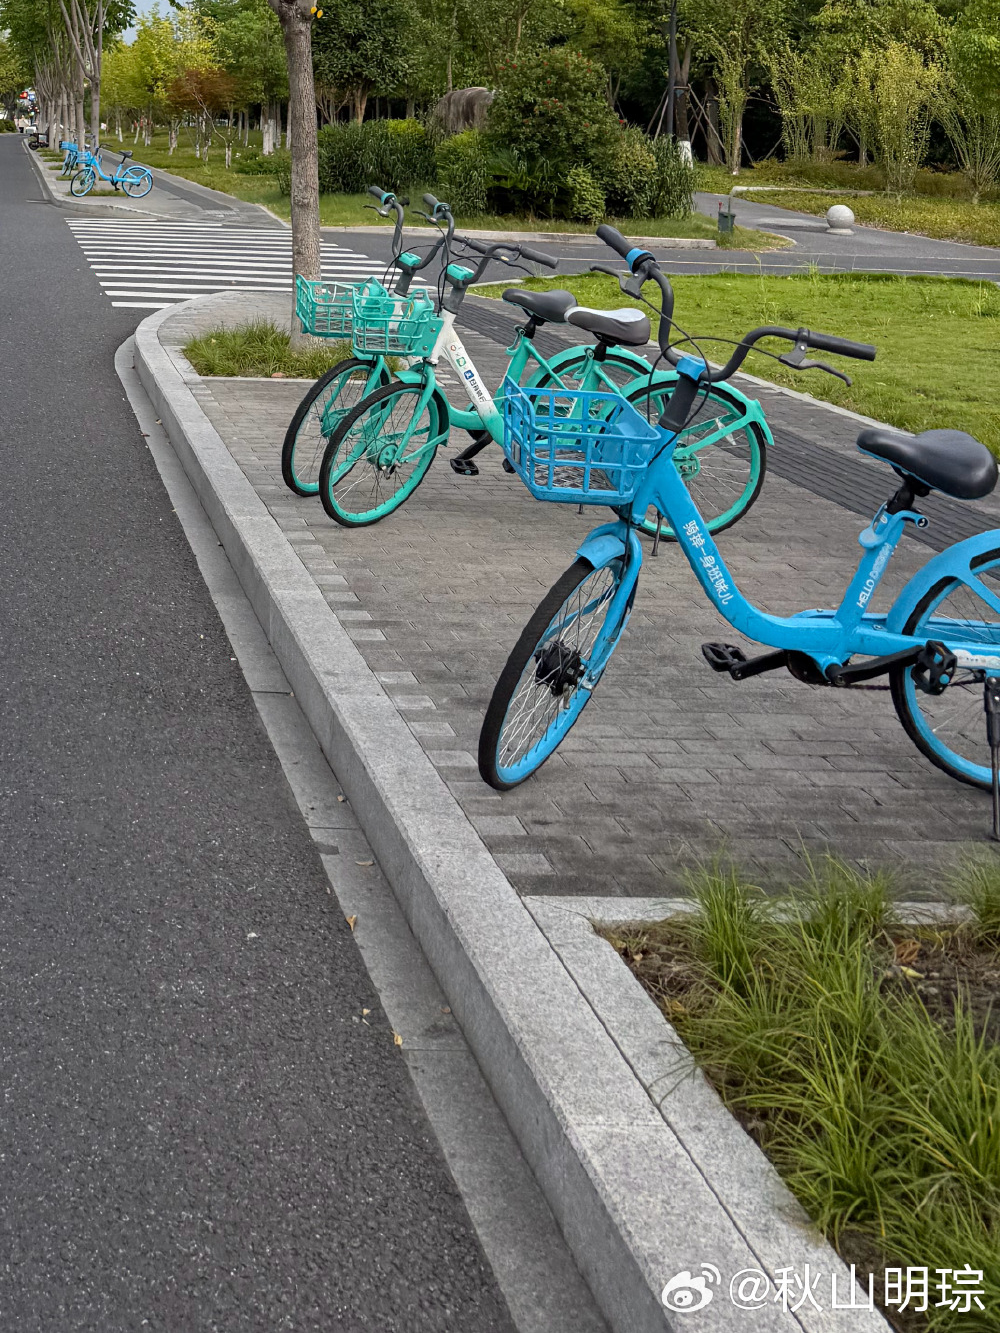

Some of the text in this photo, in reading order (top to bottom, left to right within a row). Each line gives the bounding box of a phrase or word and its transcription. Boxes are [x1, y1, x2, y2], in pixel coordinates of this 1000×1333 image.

[682, 519, 735, 605] 骑掉一身班味儿
[856, 579, 875, 608] HELLO
